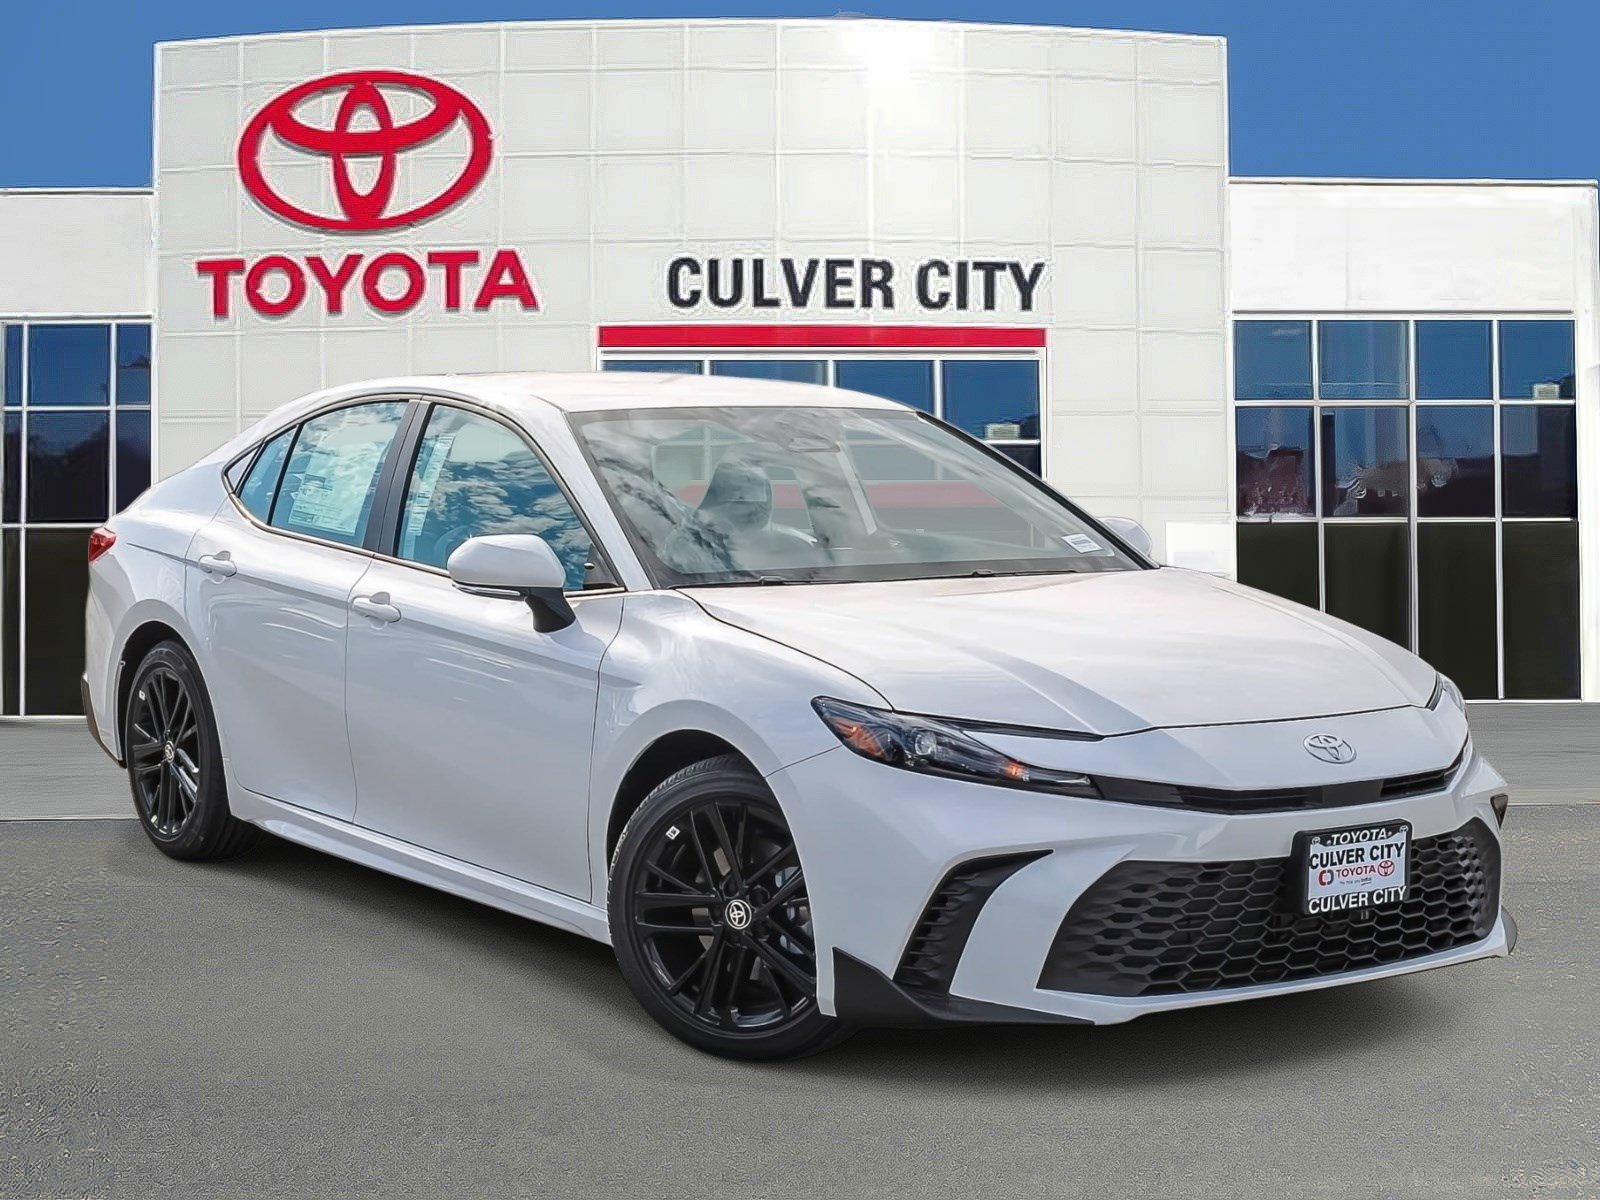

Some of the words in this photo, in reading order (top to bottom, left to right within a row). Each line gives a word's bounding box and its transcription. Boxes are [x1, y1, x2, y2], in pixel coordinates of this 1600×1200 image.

[197, 249, 539, 318] TOYOTA
[668, 257, 895, 309] CULVER
[915, 260, 1045, 312] CITY
[1331, 828, 1387, 845] TOYOTA
[1310, 847, 1365, 869] CULVER
[1370, 842, 1405, 861] CITY
[1336, 865, 1376, 878] TOYOTA
[1309, 892, 1368, 914] CULVER
[1373, 886, 1406, 905] CITY
